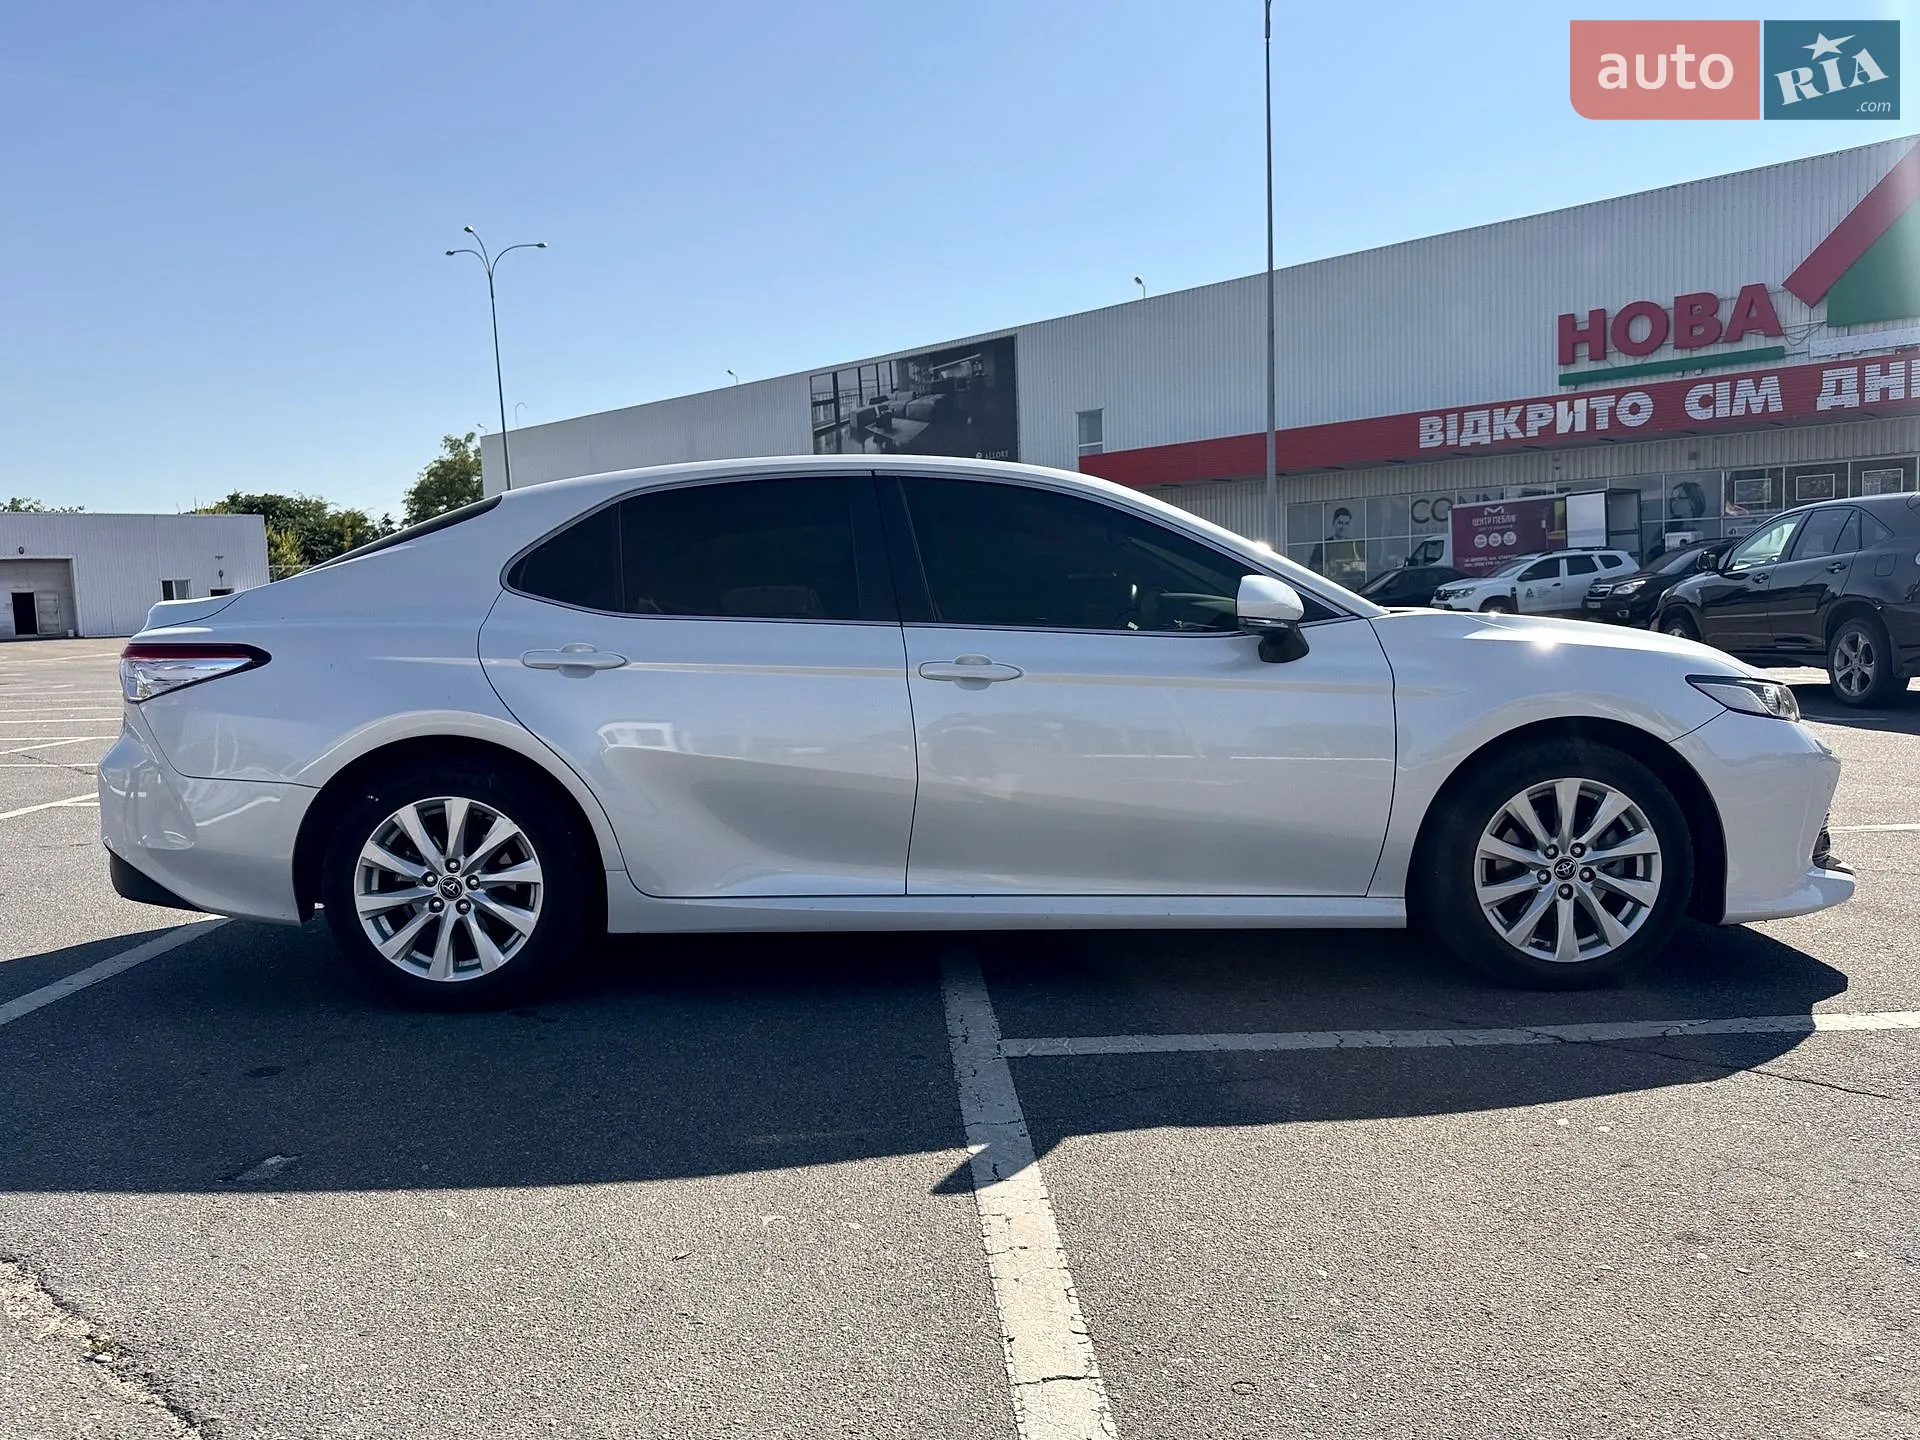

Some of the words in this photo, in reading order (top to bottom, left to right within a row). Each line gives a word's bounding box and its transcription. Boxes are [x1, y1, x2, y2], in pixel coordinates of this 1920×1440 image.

[1558, 282, 1785, 366] НОВА
[1419, 391, 1654, 449] ВІДКРИТО
[1684, 375, 1784, 421] СІМ
